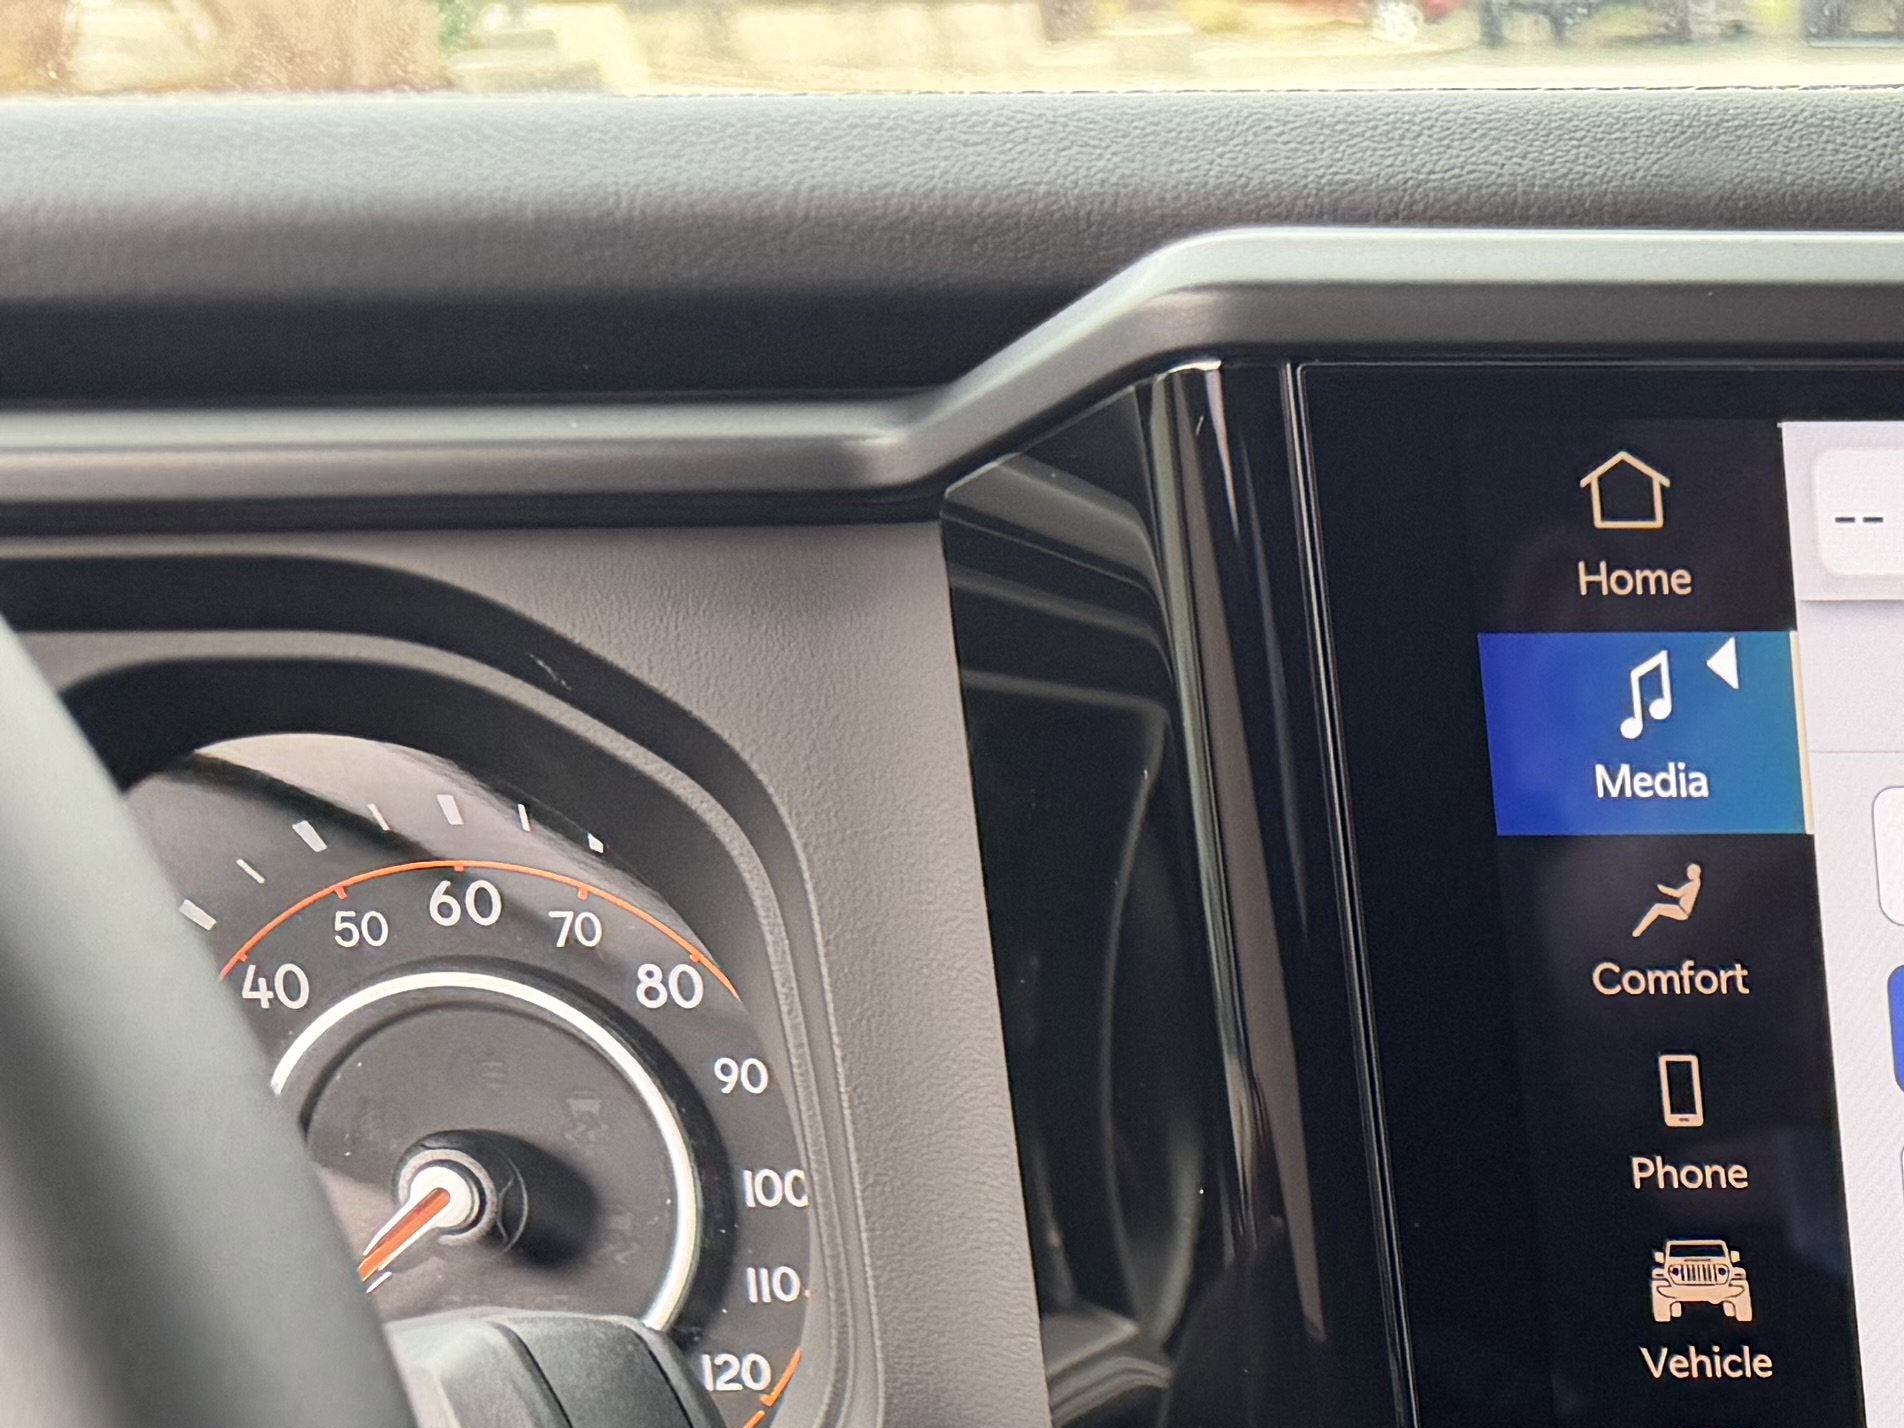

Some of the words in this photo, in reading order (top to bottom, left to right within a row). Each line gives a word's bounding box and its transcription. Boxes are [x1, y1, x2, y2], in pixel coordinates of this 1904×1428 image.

[1578, 561, 1692, 597] Home
[1595, 764, 1709, 800] Media
[429, 881, 501, 926] 60
[334, 911, 389, 948] 50
[549, 911, 601, 948] 70
[241, 964, 309, 1009] 40
[636, 964, 703, 1009] 80
[1593, 961, 1749, 997] Comfort
[714, 1058, 769, 1094] 90
[743, 1168, 809, 1208] 100
[1631, 1157, 1748, 1190] Phone
[746, 1266, 800, 1303] 110
[701, 1353, 771, 1391] 120
[1641, 1346, 1773, 1380] Vehicle
